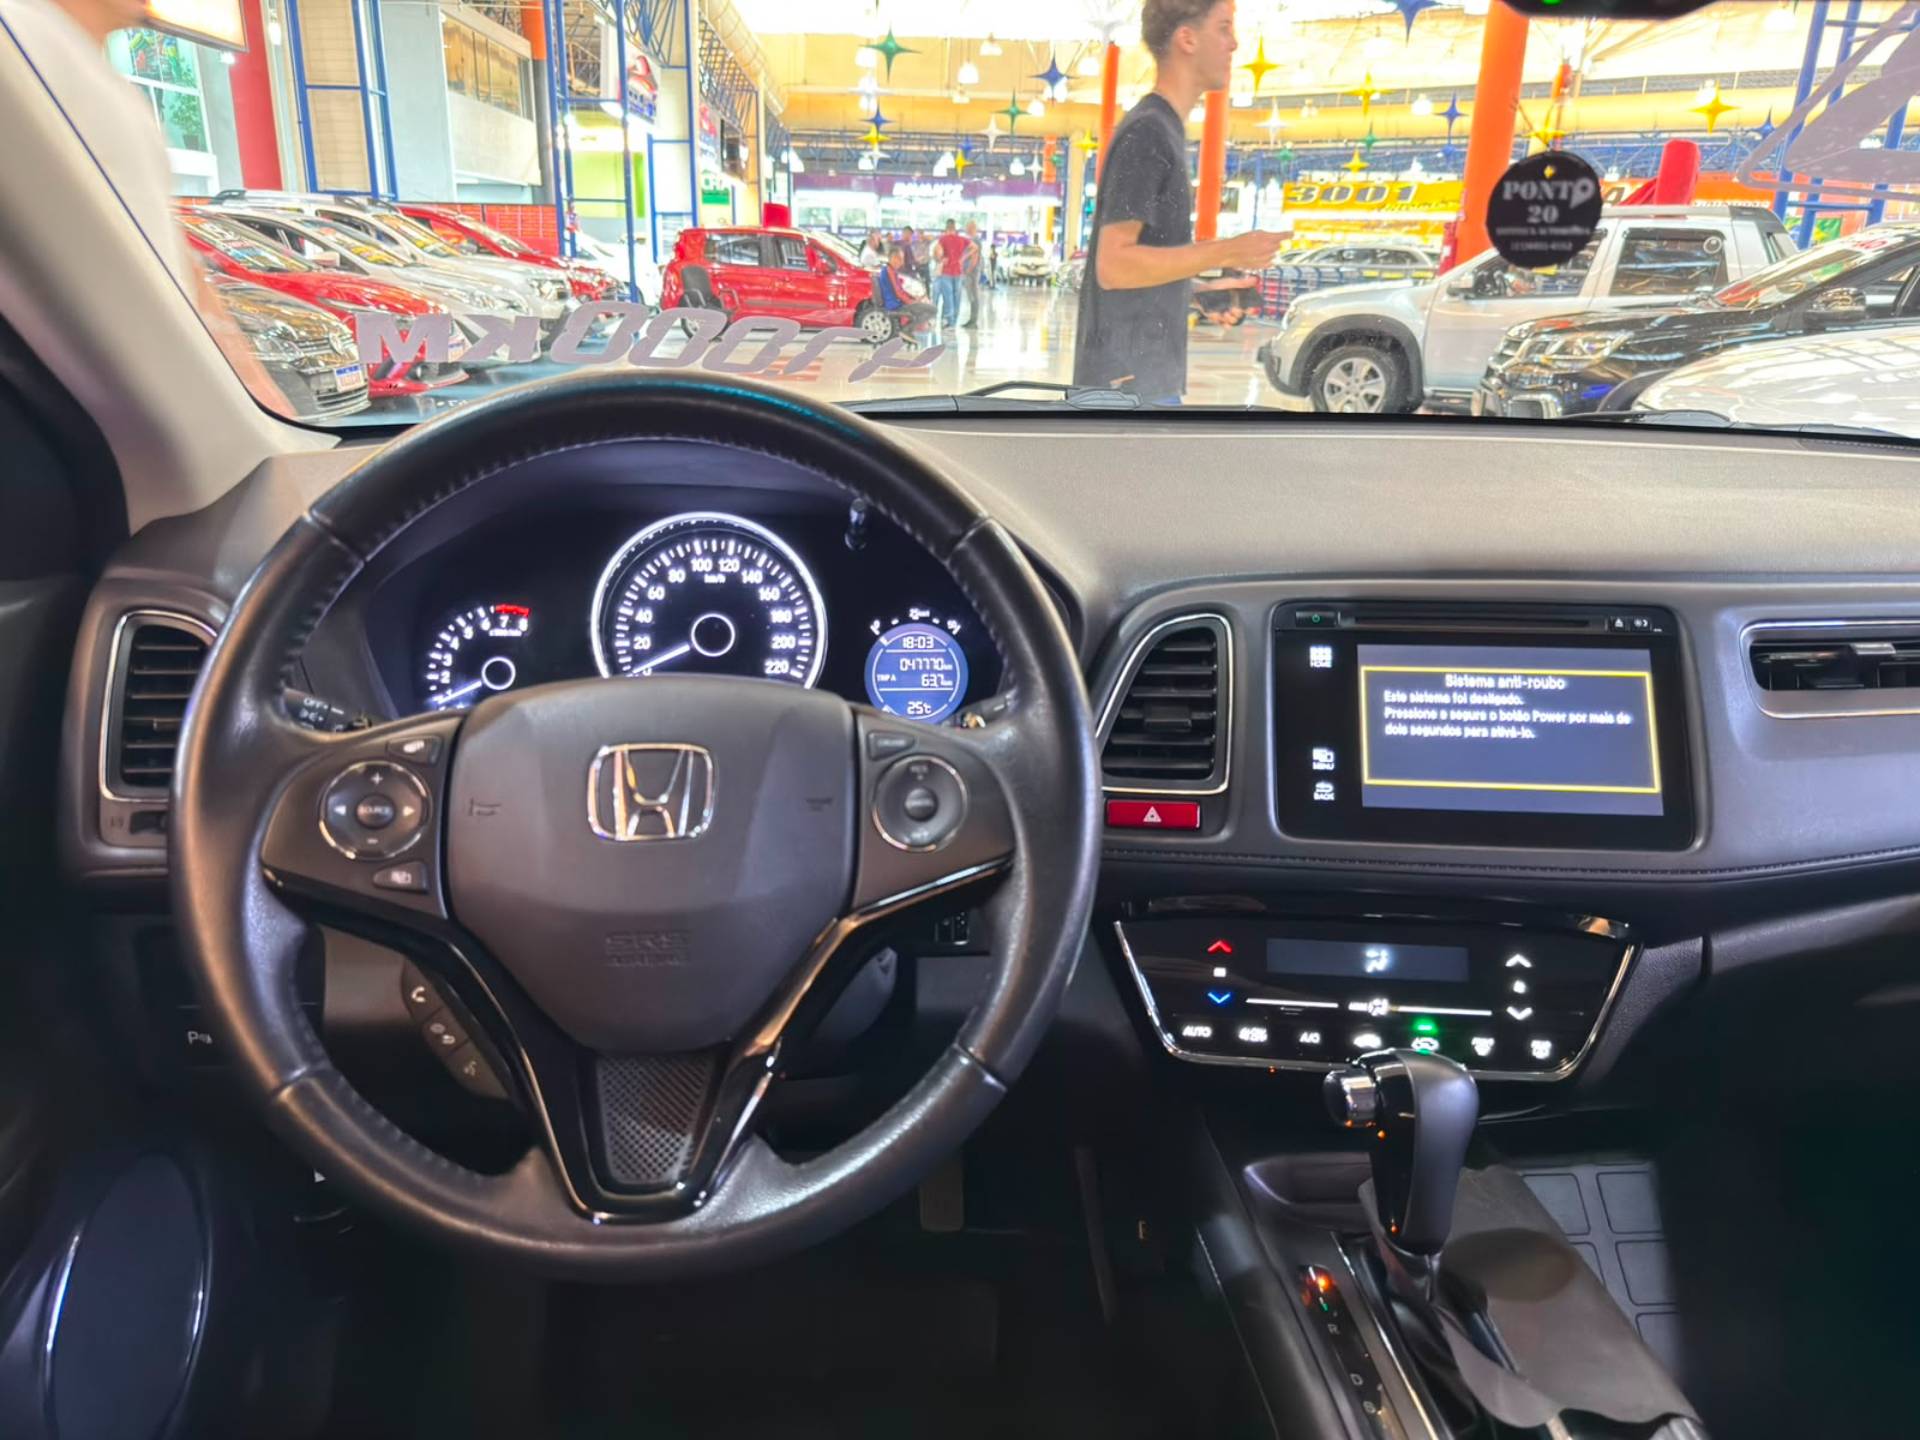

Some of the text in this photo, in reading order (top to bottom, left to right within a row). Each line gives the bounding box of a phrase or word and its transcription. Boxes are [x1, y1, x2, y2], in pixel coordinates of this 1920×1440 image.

[1288, 183, 1418, 205] 3001
[1526, 205, 1559, 224] 20
[691, 558, 712, 572] 100
[719, 558, 740, 572] 120
[668, 569, 686, 583] 80
[741, 569, 763, 583] 140
[648, 586, 665, 600] 60
[759, 587, 780, 600] 160
[500, 615, 509, 628] 7
[635, 609, 653, 623] 40
[771, 609, 792, 623] 180
[481, 617, 491, 631] 6
[519, 618, 528, 632] 8
[463, 626, 474, 640] 5
[450, 636, 460, 650] 4
[633, 636, 651, 650] 20
[772, 635, 795, 649] 200
[902, 635, 934, 649] 18:03
[443, 653, 453, 667] 3
[765, 661, 788, 675] 220
[441, 670, 451, 684] 2
[1444, 673, 1568, 690] Sistema anti-roubo
[1383, 690, 1524, 707] Este sistema foi desligado.
[1383, 706, 1633, 726] Pressione e segure o botão Power por mais de
[1384, 722, 1409, 736] dois
[1409, 724, 1462, 738] segundos
[1463, 727, 1490, 739] para
[1312, 761, 1335, 771] MENU
[1313, 791, 1336, 801] BACK
[1182, 1025, 1212, 1038] AUTO
[1299, 1032, 1320, 1044] A/C
[1349, 1373, 1364, 1387] D
